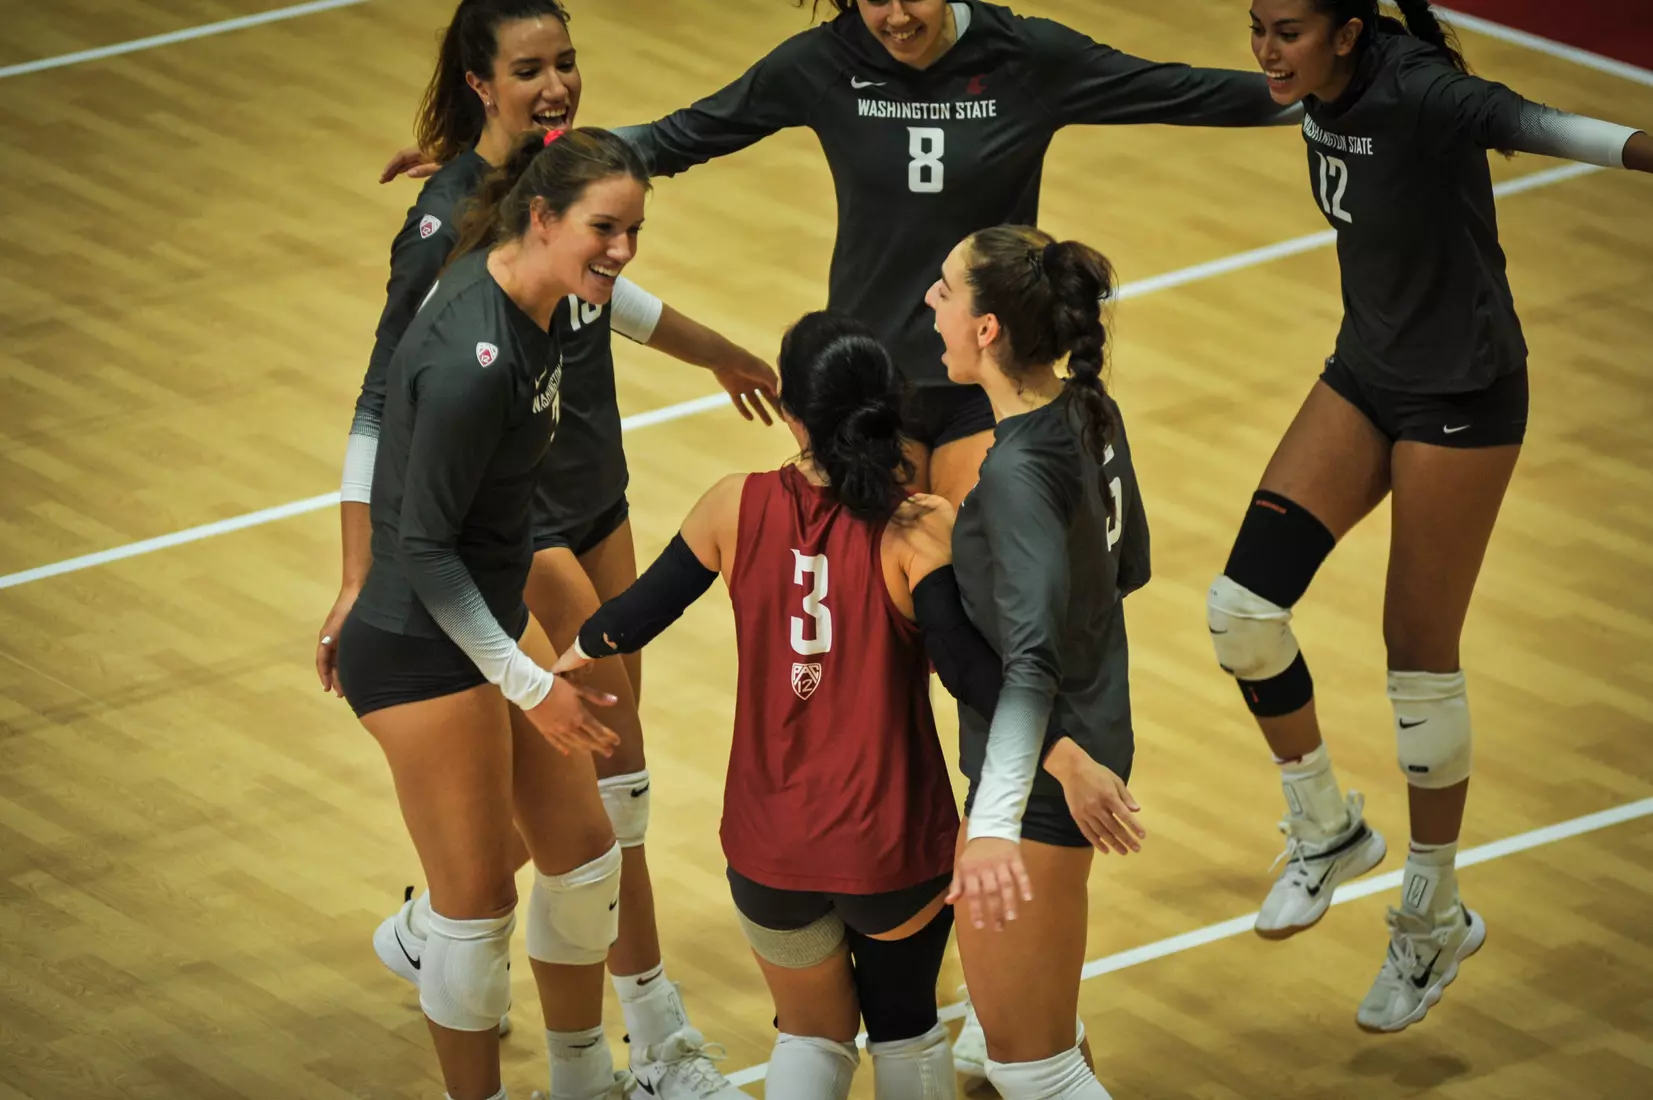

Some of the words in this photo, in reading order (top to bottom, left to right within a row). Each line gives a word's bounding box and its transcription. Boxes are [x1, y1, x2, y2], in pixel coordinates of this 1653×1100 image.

[858, 98, 950, 119] WASHINGTON
[955, 100, 997, 119] STATE
[1303, 112, 1347, 152] WASHINGTON
[1348, 135, 1374, 154] STATE
[906, 126, 945, 193] 8
[1315, 150, 1352, 223] 12
[790, 548, 832, 655] 3
[793, 665, 819, 686] PAC
[797, 679, 812, 693] 12
